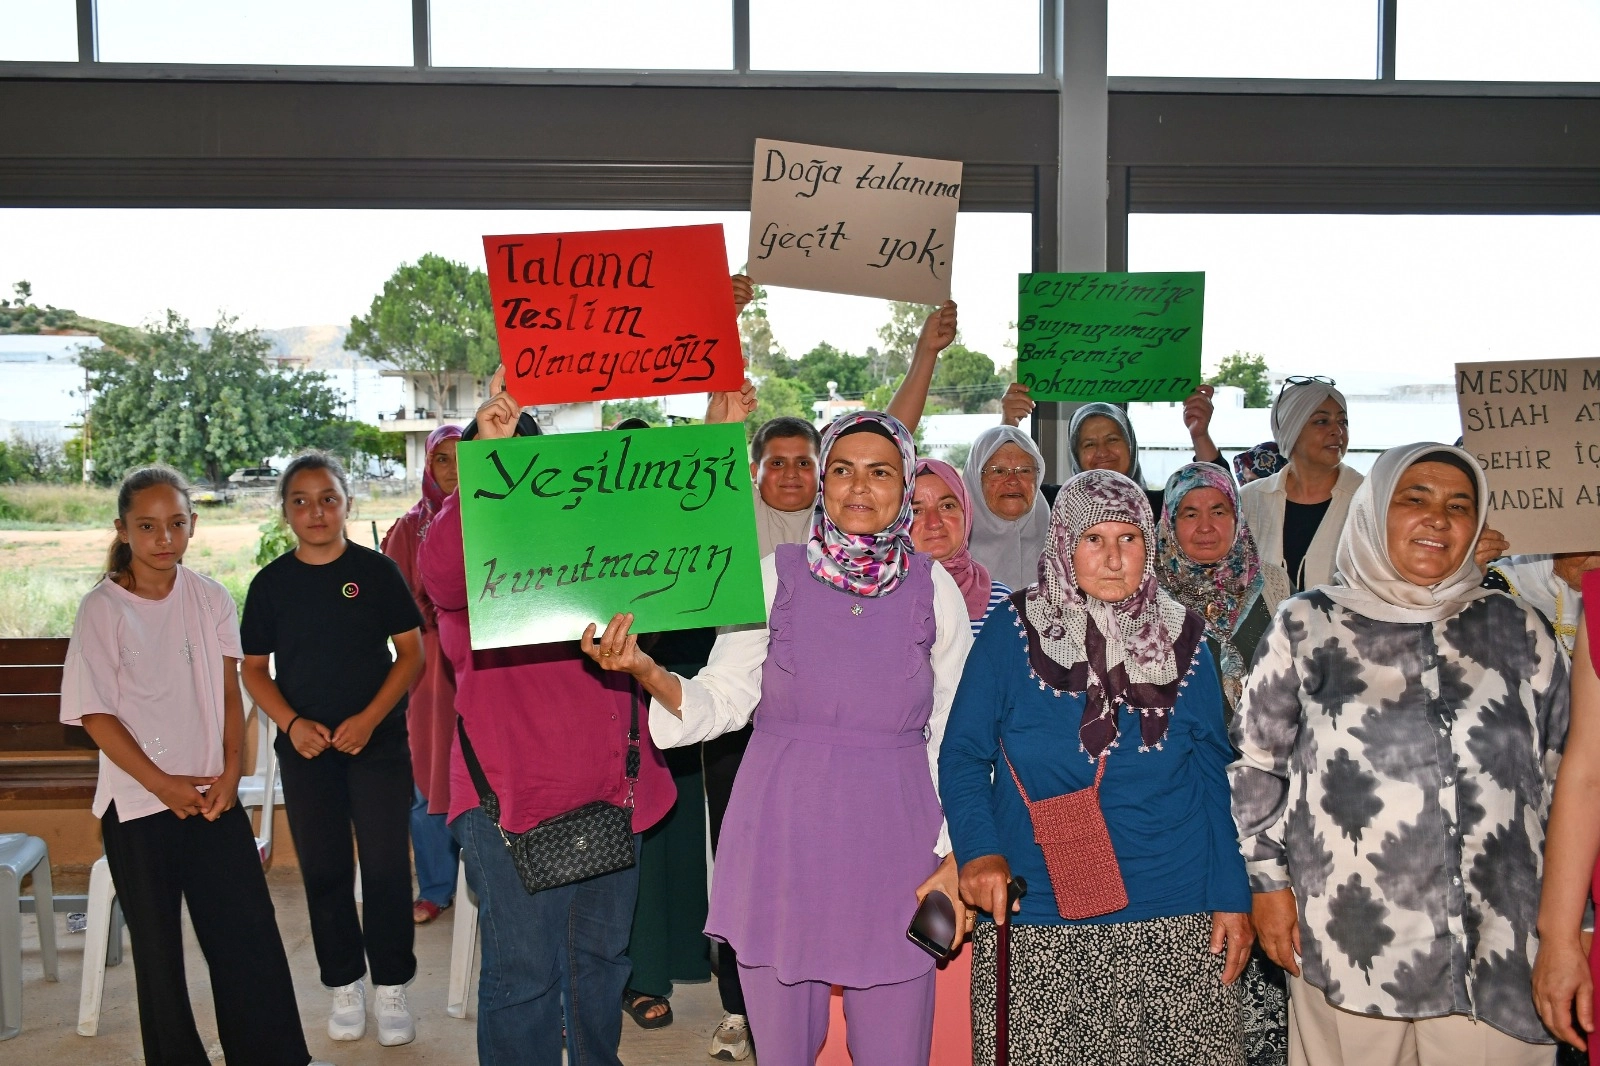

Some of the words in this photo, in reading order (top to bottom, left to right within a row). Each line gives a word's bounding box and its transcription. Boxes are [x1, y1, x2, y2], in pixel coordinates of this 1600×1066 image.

[762, 149, 842, 198] Doğa
[855, 162, 960, 199] talanına
[497, 237, 655, 288] Talana
[866, 228, 945, 280] yok.
[501, 293, 646, 338] Teslim
[515, 334, 719, 393] Olmayacağız
[1017, 341, 1143, 373] Bahçemize
[1459, 368, 1567, 395] MESKUN
[1467, 401, 1549, 431] SİLAH
[478, 544, 733, 615] kurutmayın
